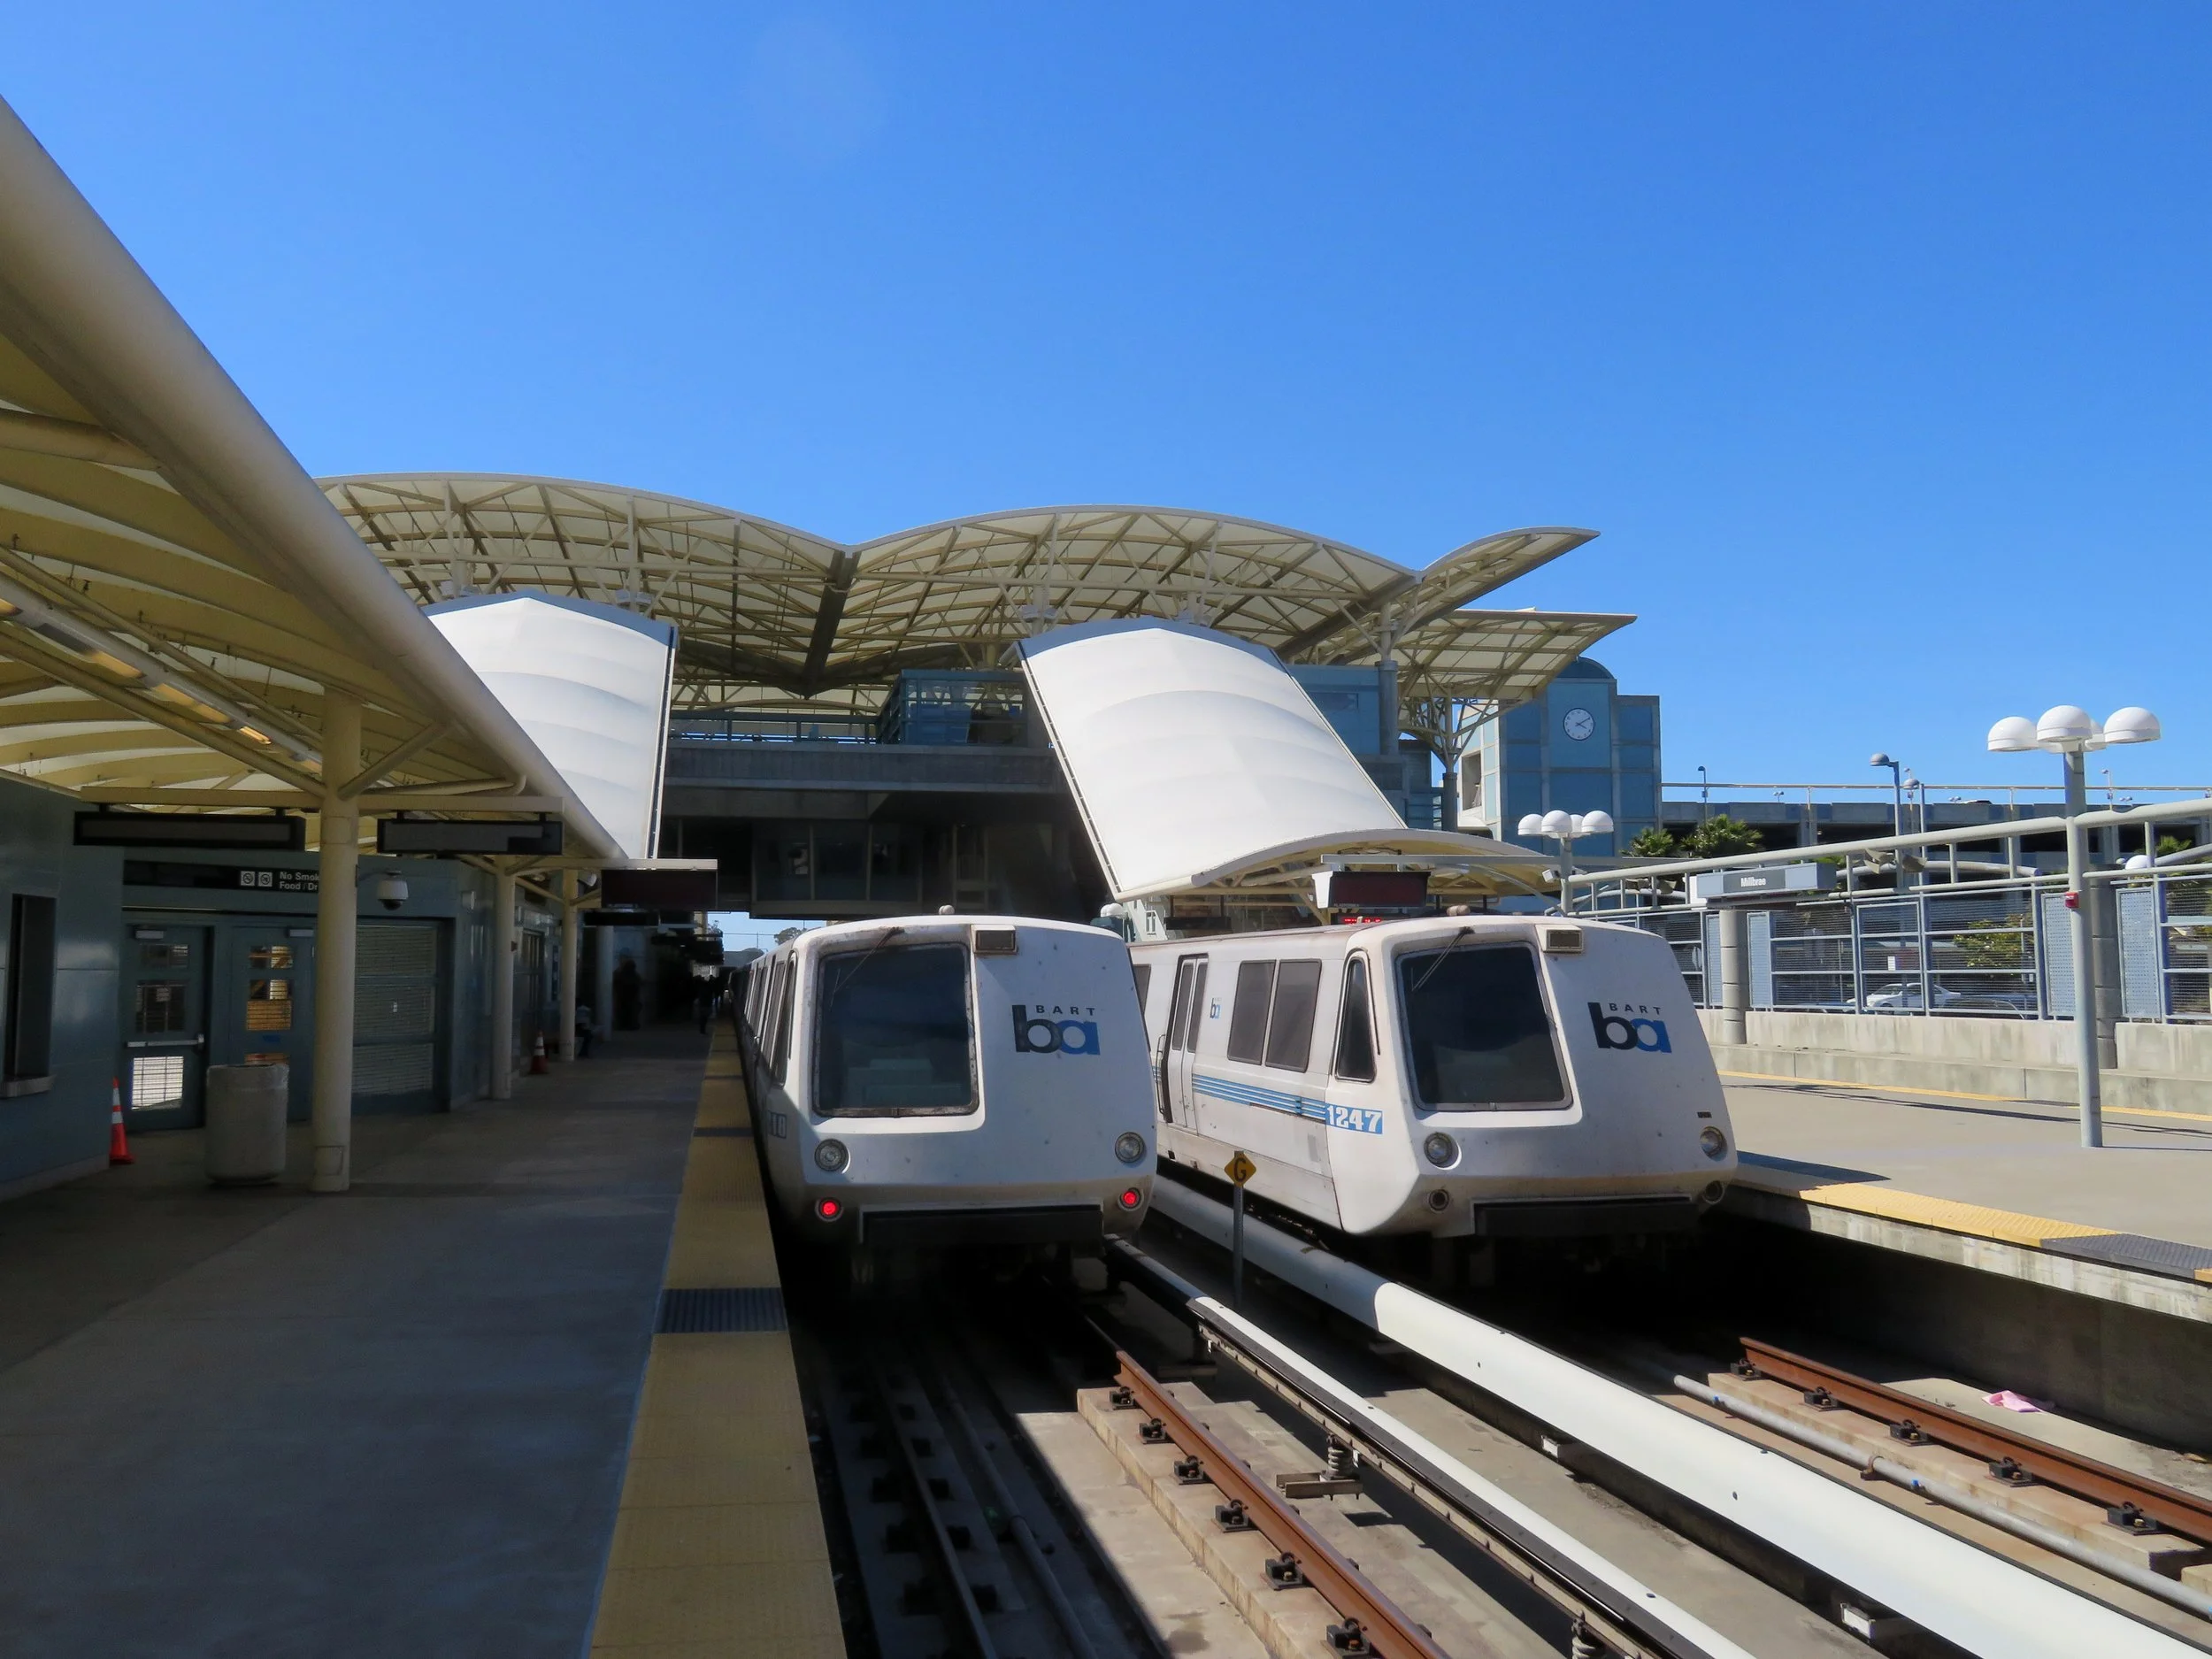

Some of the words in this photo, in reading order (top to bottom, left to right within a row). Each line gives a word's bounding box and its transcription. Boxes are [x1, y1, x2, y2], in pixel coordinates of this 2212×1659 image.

[280, 872, 292, 880] No
[1740, 877, 1766, 887] Millbrae
[280, 881, 301, 890] Food
[1035, 1004, 1095, 1016] BART
[1609, 1002, 1662, 1016] BART
[1011, 1004, 1100, 1056] ba
[1587, 1002, 1672, 1054] ba
[1327, 1105, 1382, 1133] 1247
[1233, 1157, 1247, 1183] G
